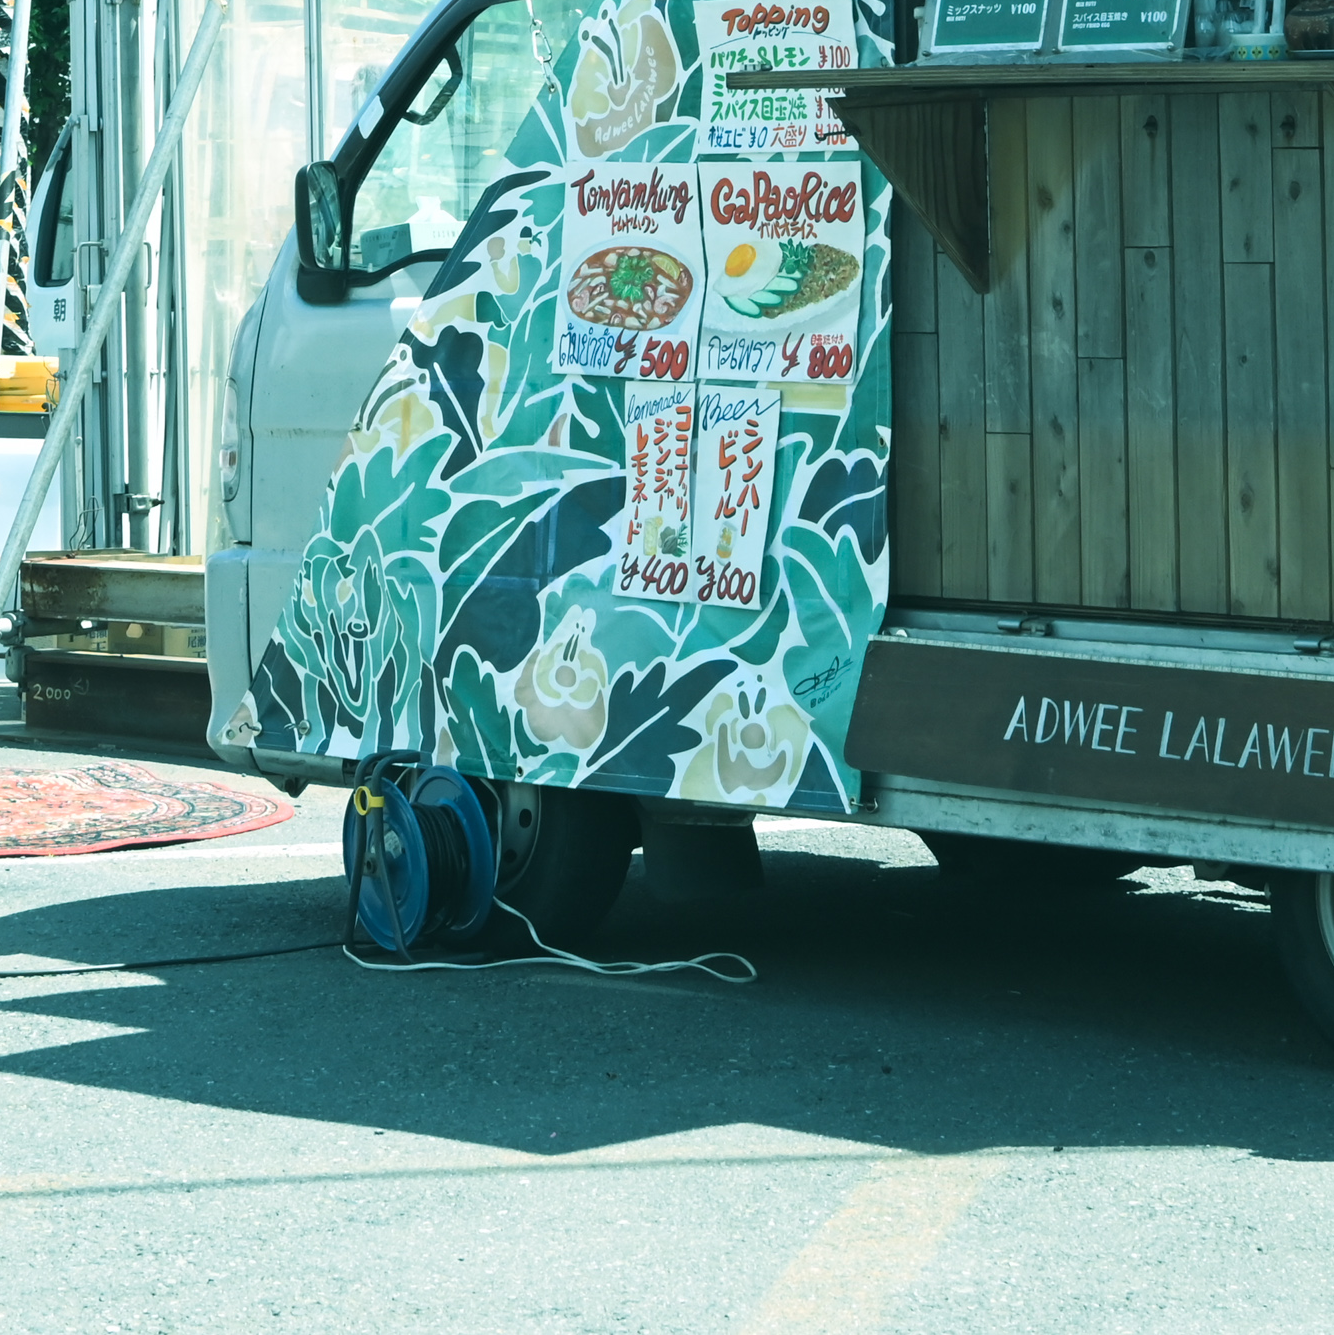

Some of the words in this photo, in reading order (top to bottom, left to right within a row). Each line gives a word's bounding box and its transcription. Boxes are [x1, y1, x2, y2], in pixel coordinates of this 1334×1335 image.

[721, 3, 830, 36] Topping
[947, 4, 1001, 16] ミックスナッツ
[1011, 3, 1036, 15] ¥100
[1141, 11, 1167, 23] ¥100
[818, 45, 851, 69] ¥100
[627, 423, 649, 545] レモネード
[653, 418, 675, 512] ジンジャー
[675, 406, 692, 521] ココナッツ
[714, 429, 738, 520] ビール
[736, 419, 764, 537] シンハー
[33, 683, 71, 701] 2000
[1003, 695, 1144, 755] ADWEE
